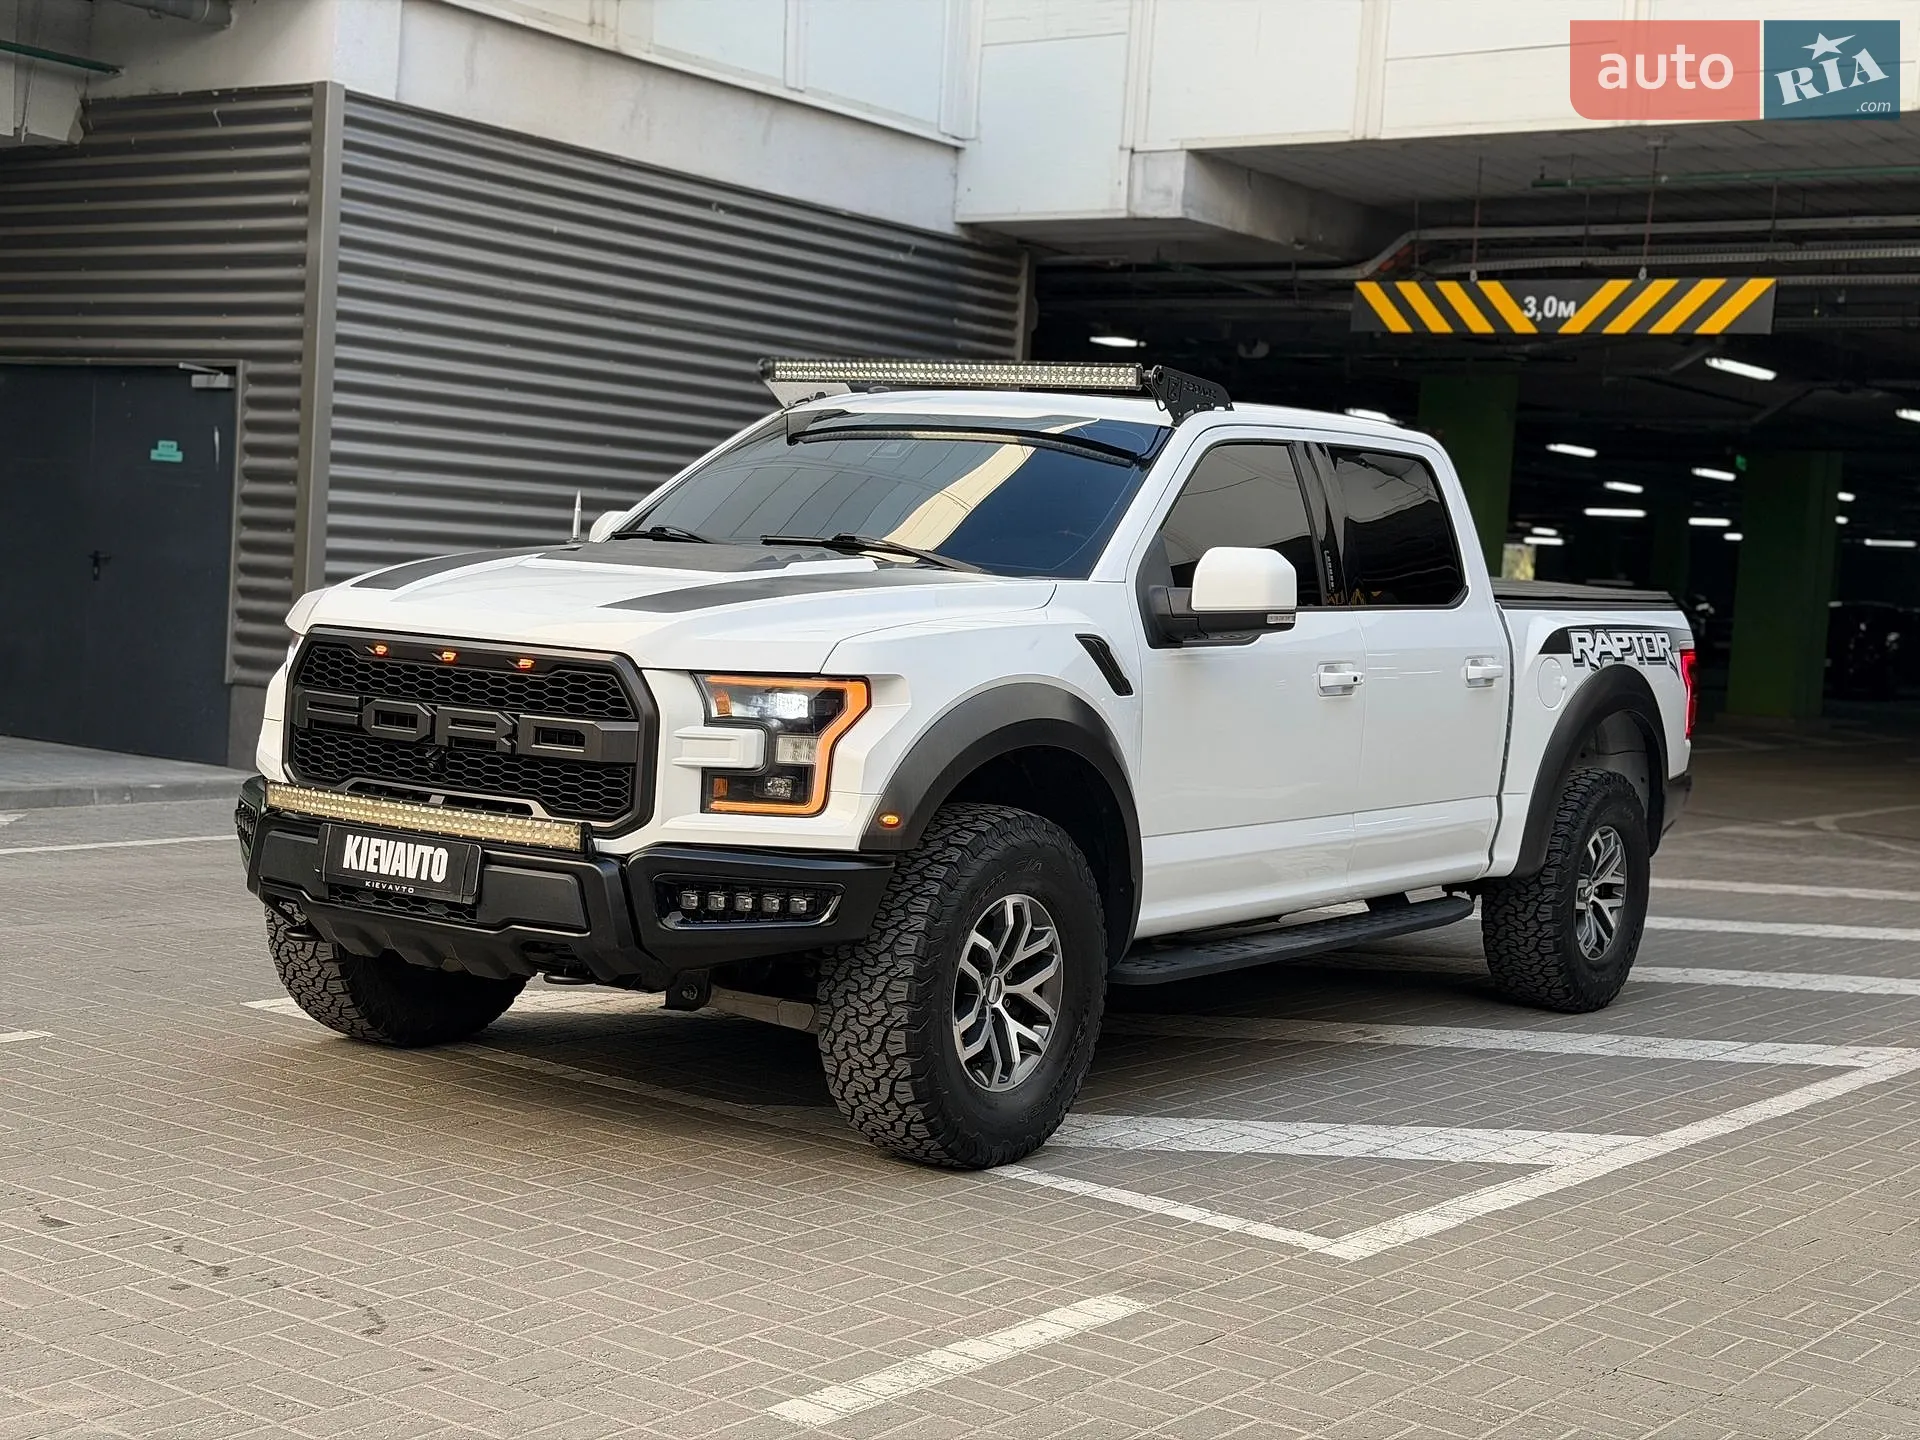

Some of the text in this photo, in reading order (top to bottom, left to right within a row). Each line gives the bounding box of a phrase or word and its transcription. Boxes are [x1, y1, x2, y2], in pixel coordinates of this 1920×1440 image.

[1568, 630, 1680, 674] RAPTOR
[294, 686, 612, 759] FORD
[342, 834, 449, 883] KIEVAVTO
[365, 880, 415, 894] KIEVAVTO
